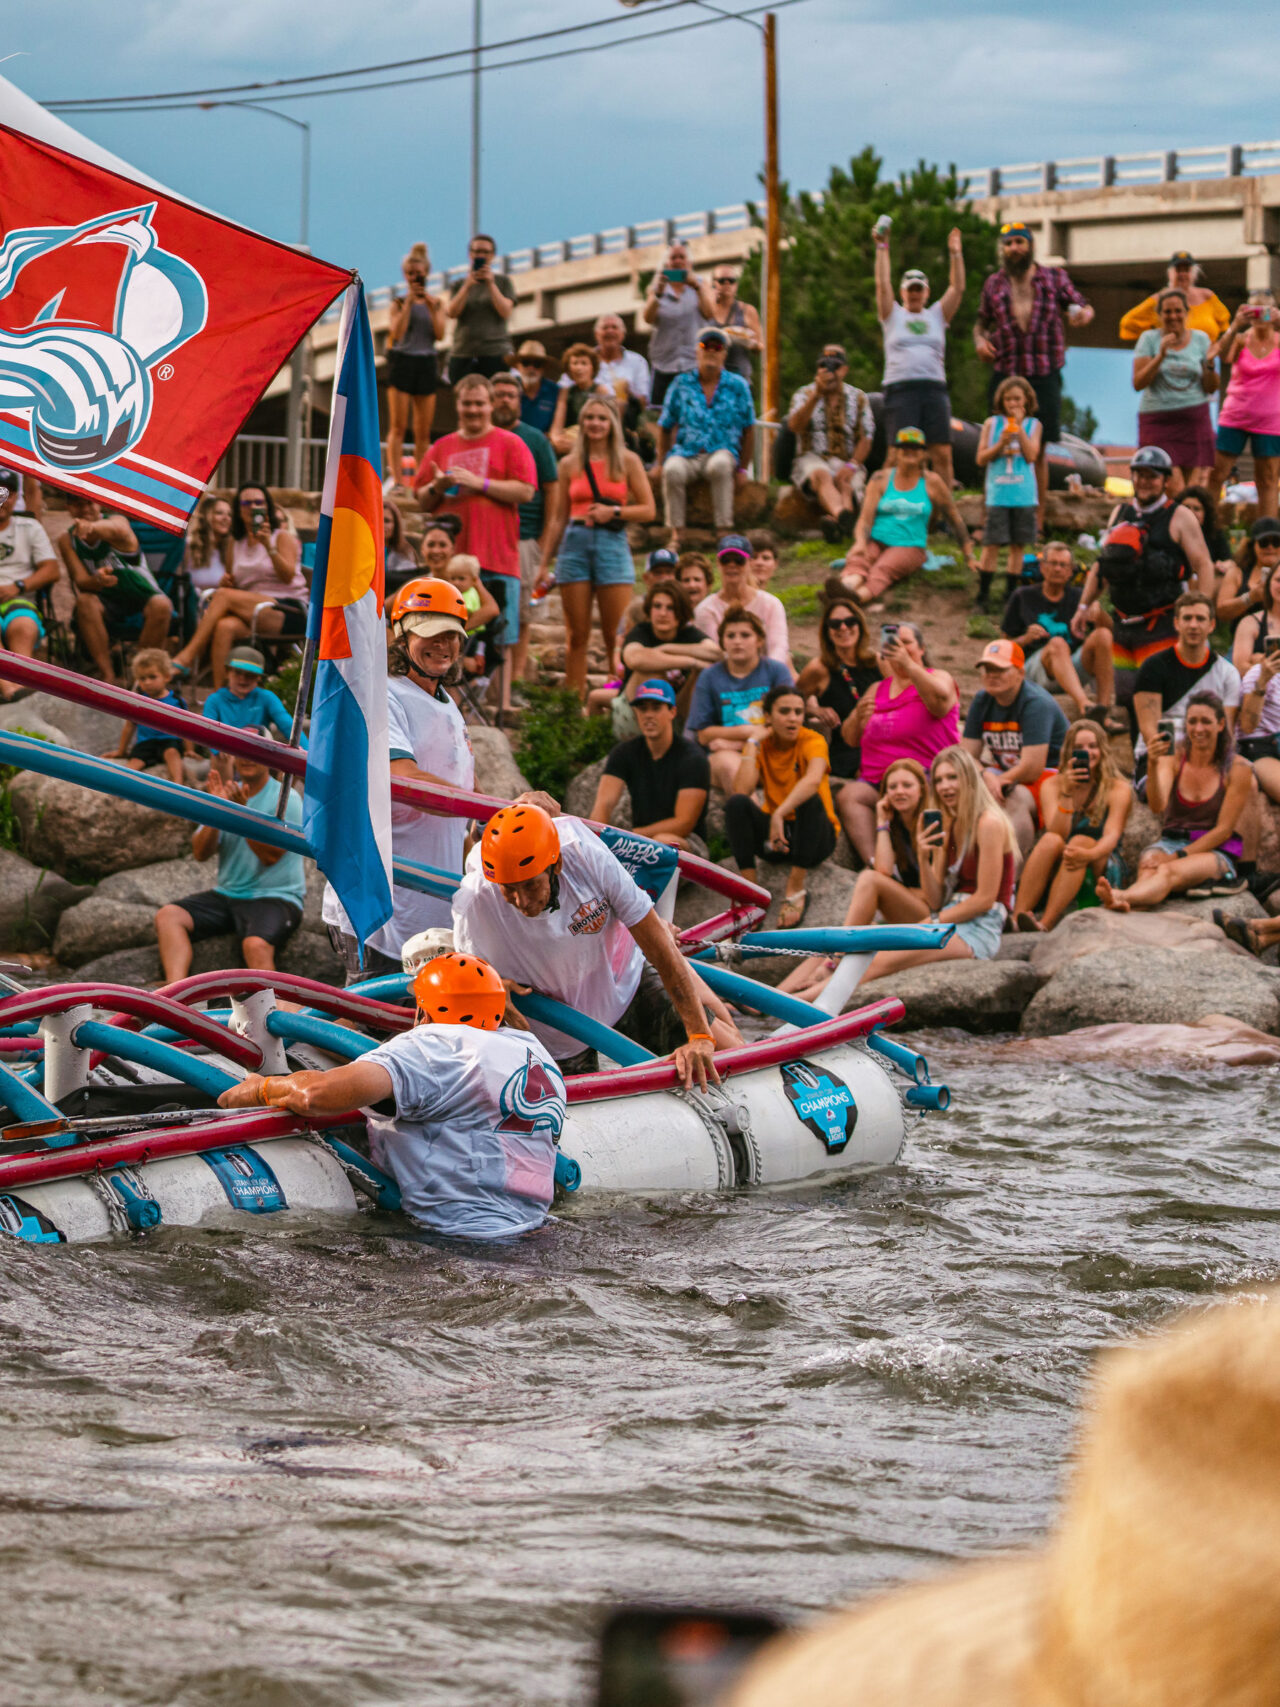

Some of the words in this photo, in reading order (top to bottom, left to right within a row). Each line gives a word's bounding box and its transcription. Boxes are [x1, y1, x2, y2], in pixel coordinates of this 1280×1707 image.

[610, 837, 664, 865] CHEERS
[800, 1092, 850, 1114] CHAMPIONS
[829, 1125, 841, 1134] BUD
[828, 1132, 844, 1142] LIGHT
[232, 1184, 279, 1196] CHAMPIONS
